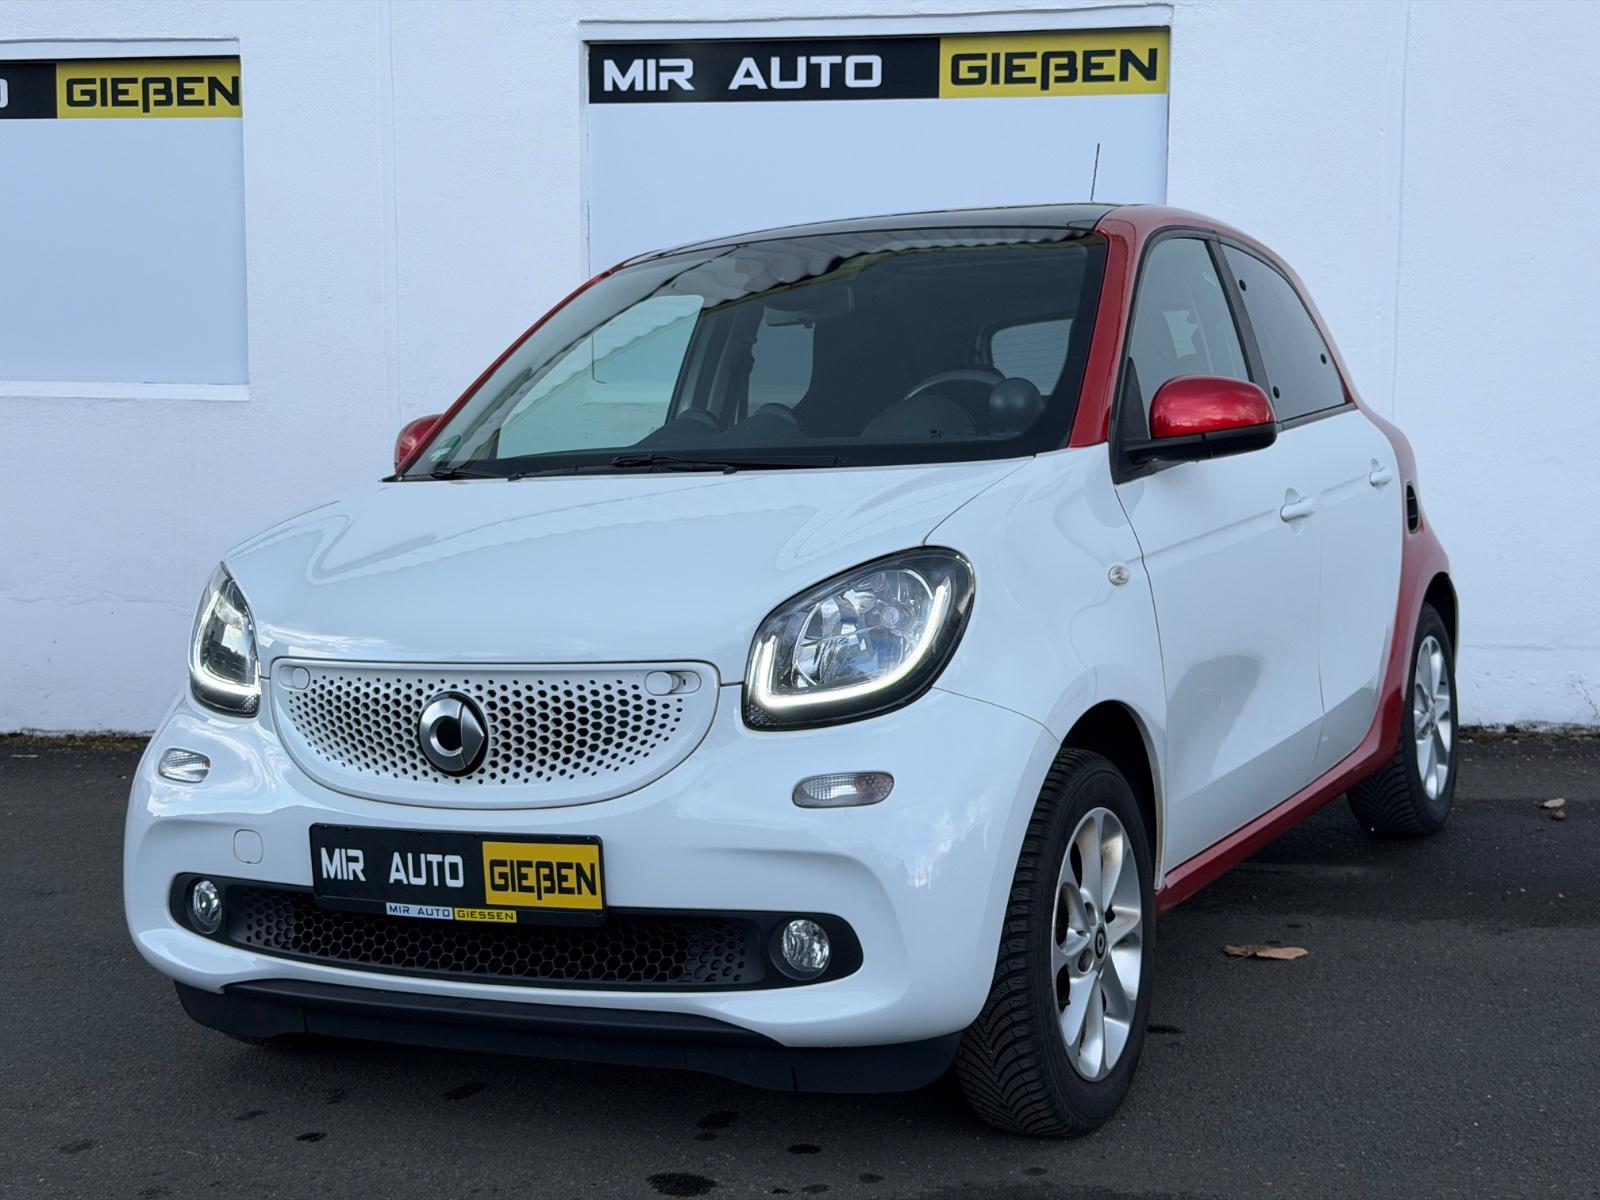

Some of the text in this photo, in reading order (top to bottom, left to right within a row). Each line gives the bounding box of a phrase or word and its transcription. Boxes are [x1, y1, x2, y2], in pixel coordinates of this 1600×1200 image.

[602, 58, 695, 92] MIR
[727, 55, 882, 90] AUTO
[320, 847, 366, 882] MIR
[388, 851, 465, 888] AUTO
[388, 904, 515, 921] MIR AUTO GIESSEN
